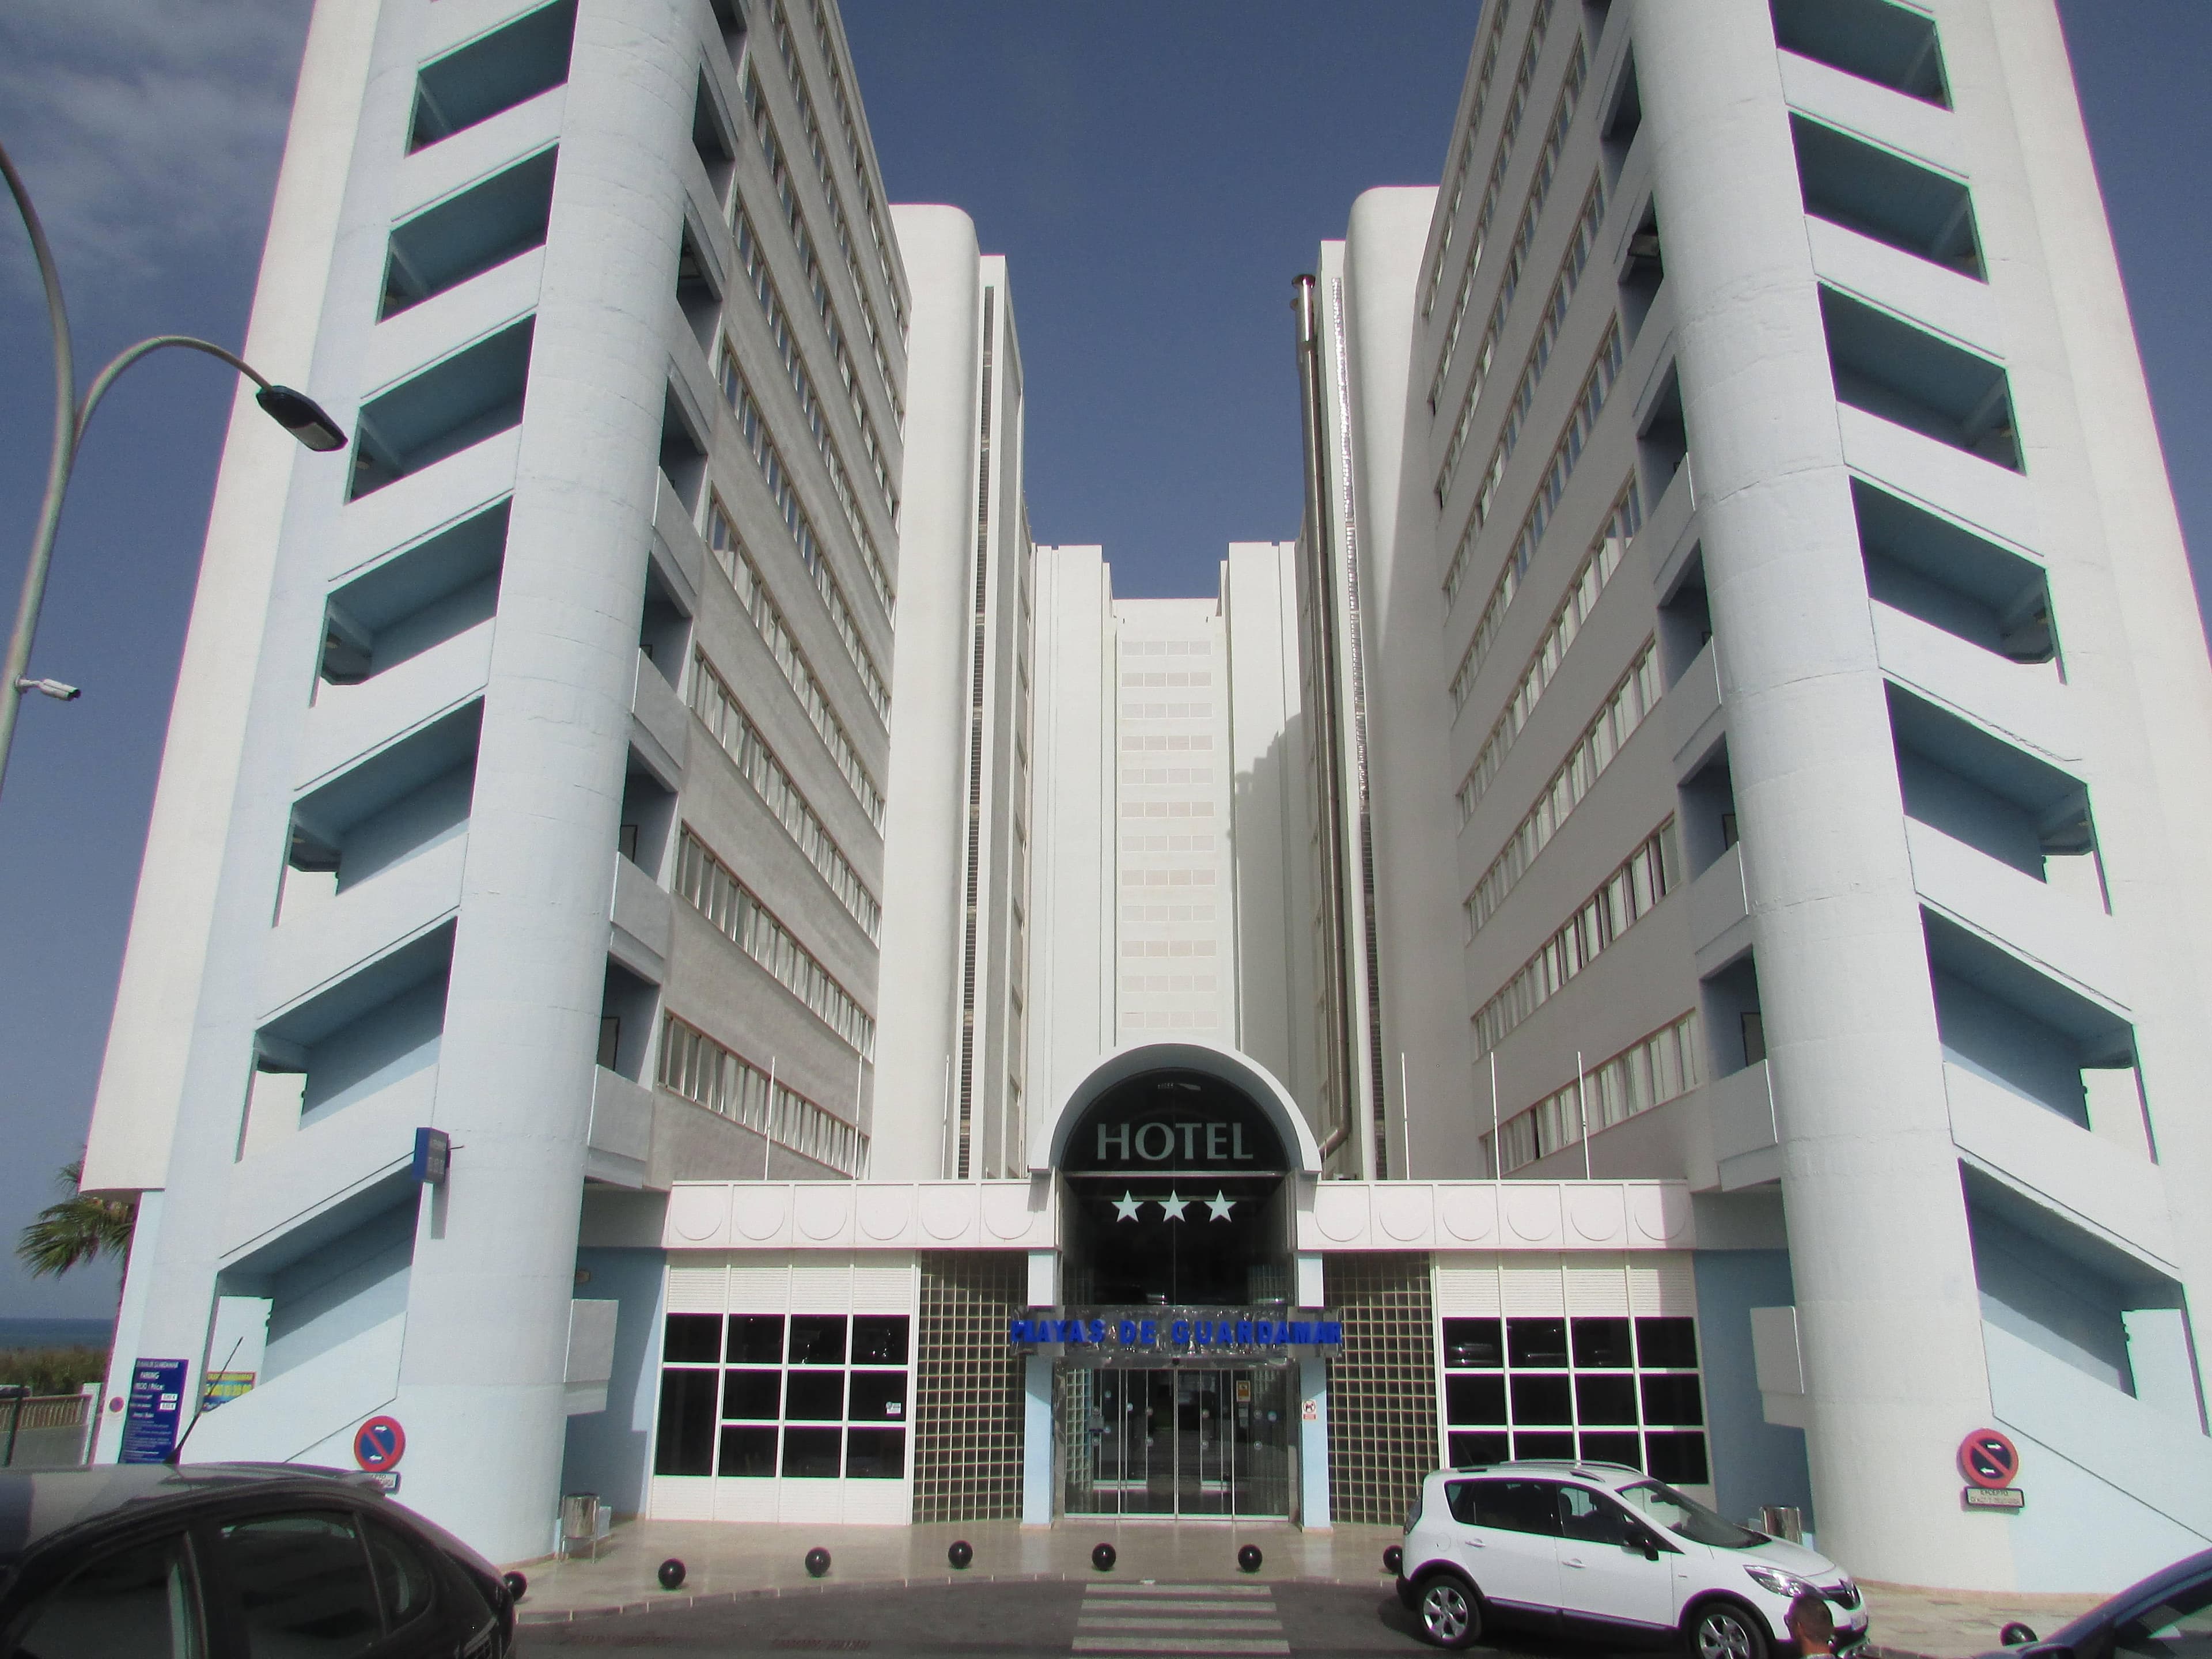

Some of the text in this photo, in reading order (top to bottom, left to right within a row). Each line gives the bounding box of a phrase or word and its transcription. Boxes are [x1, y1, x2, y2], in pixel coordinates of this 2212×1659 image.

[1097, 1123, 1253, 1160] HOTEL
[1010, 1319, 1343, 1344] PLAYAS DE GUARDAMAR
